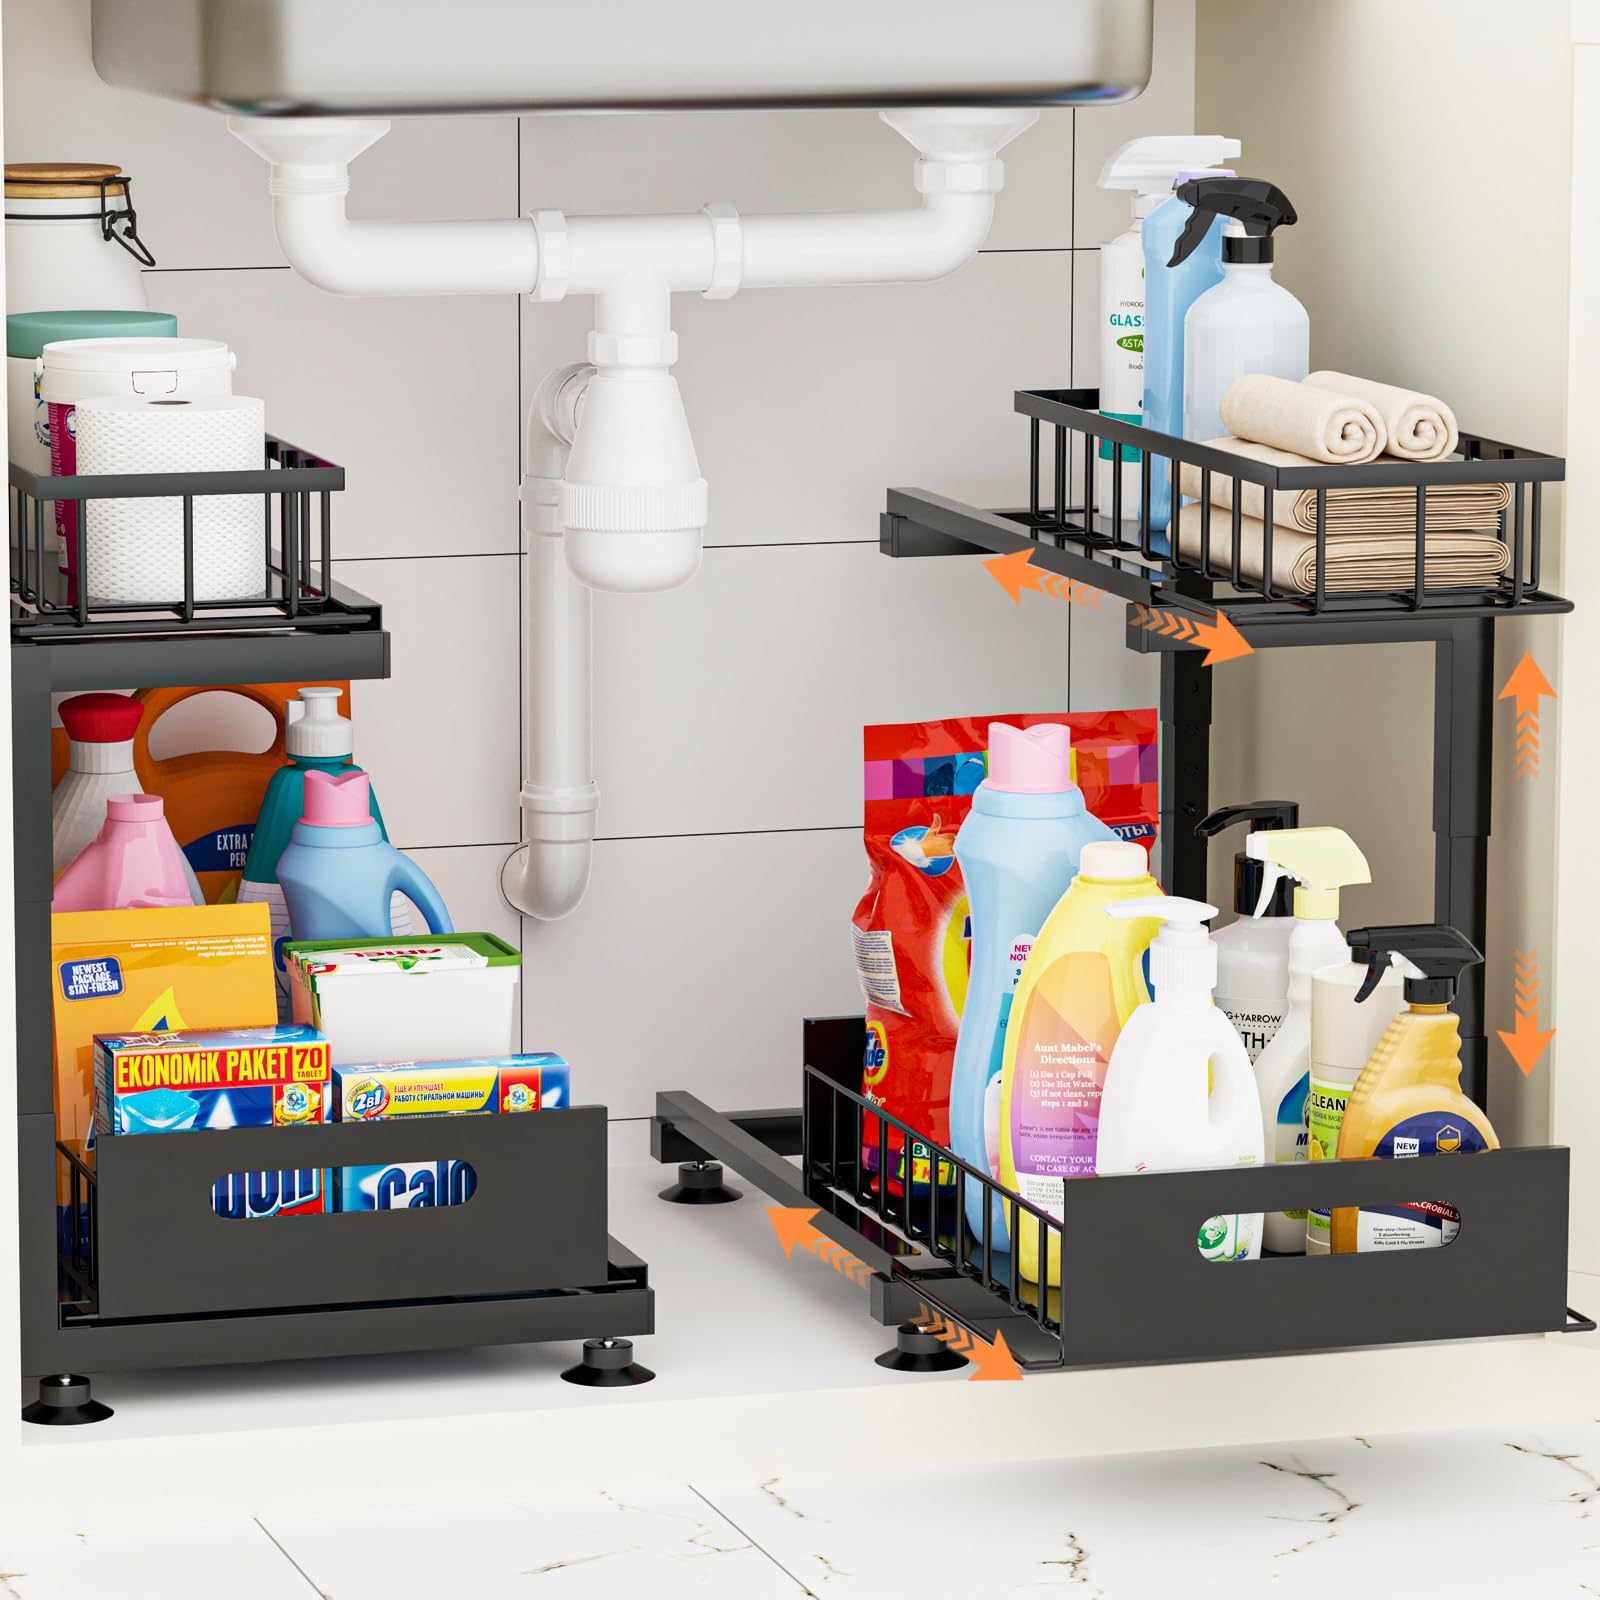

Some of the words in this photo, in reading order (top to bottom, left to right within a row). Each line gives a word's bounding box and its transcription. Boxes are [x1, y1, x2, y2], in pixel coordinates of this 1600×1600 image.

[1109, 313, 1145, 327] GLAS
[1121, 338, 1144, 348] &STA
[216, 833, 248, 851] EXTRA
[230, 852, 247, 868] PER
[71, 961, 107, 976] NEWEST
[72, 970, 112, 986] PACKAGE
[67, 979, 119, 996] STAY-FRESH
[1223, 1010, 1282, 1024] G+YARROW
[1241, 1031, 1275, 1050] TH-
[1033, 1042, 1058, 1053] Aunt
[1060, 1041, 1102, 1053] Mabel's
[226, 1047, 288, 1082] PAKET
[295, 1047, 323, 1070] 70
[1040, 1054, 1096, 1065] Directions
[297, 1069, 323, 1079] TABLET
[1061, 1071, 1076, 1080] Cap
[394, 1085, 407, 1093] ЕЩЕ
[413, 1083, 444, 1093] УЛУЧШАЕТ
[1056, 1080, 1071, 1088] Hot
[1072, 1080, 1097, 1088] Water
[394, 1094, 416, 1103] РАБОТУ
[416, 1091, 455, 1102] СТИРАЛЬНОЙ
[455, 1090, 485, 1099] МАШИНЫ
[1049, 1090, 1061, 1098] not
[1062, 1089, 1086, 1099] clean,
[1041, 1100, 1060, 1109] steps
[1067, 1099, 1082, 1107] and
[1311, 1092, 1346, 1112] CLEAN
[1295, 1132, 1309, 1146] M
[1396, 1142, 1418, 1150] NEW
[1030, 1154, 1067, 1163] CONTACT
[1068, 1155, 1094, 1164] YOUR
[1046, 1164, 1068, 1173] CASE
[1069, 1165, 1082, 1173] OF
